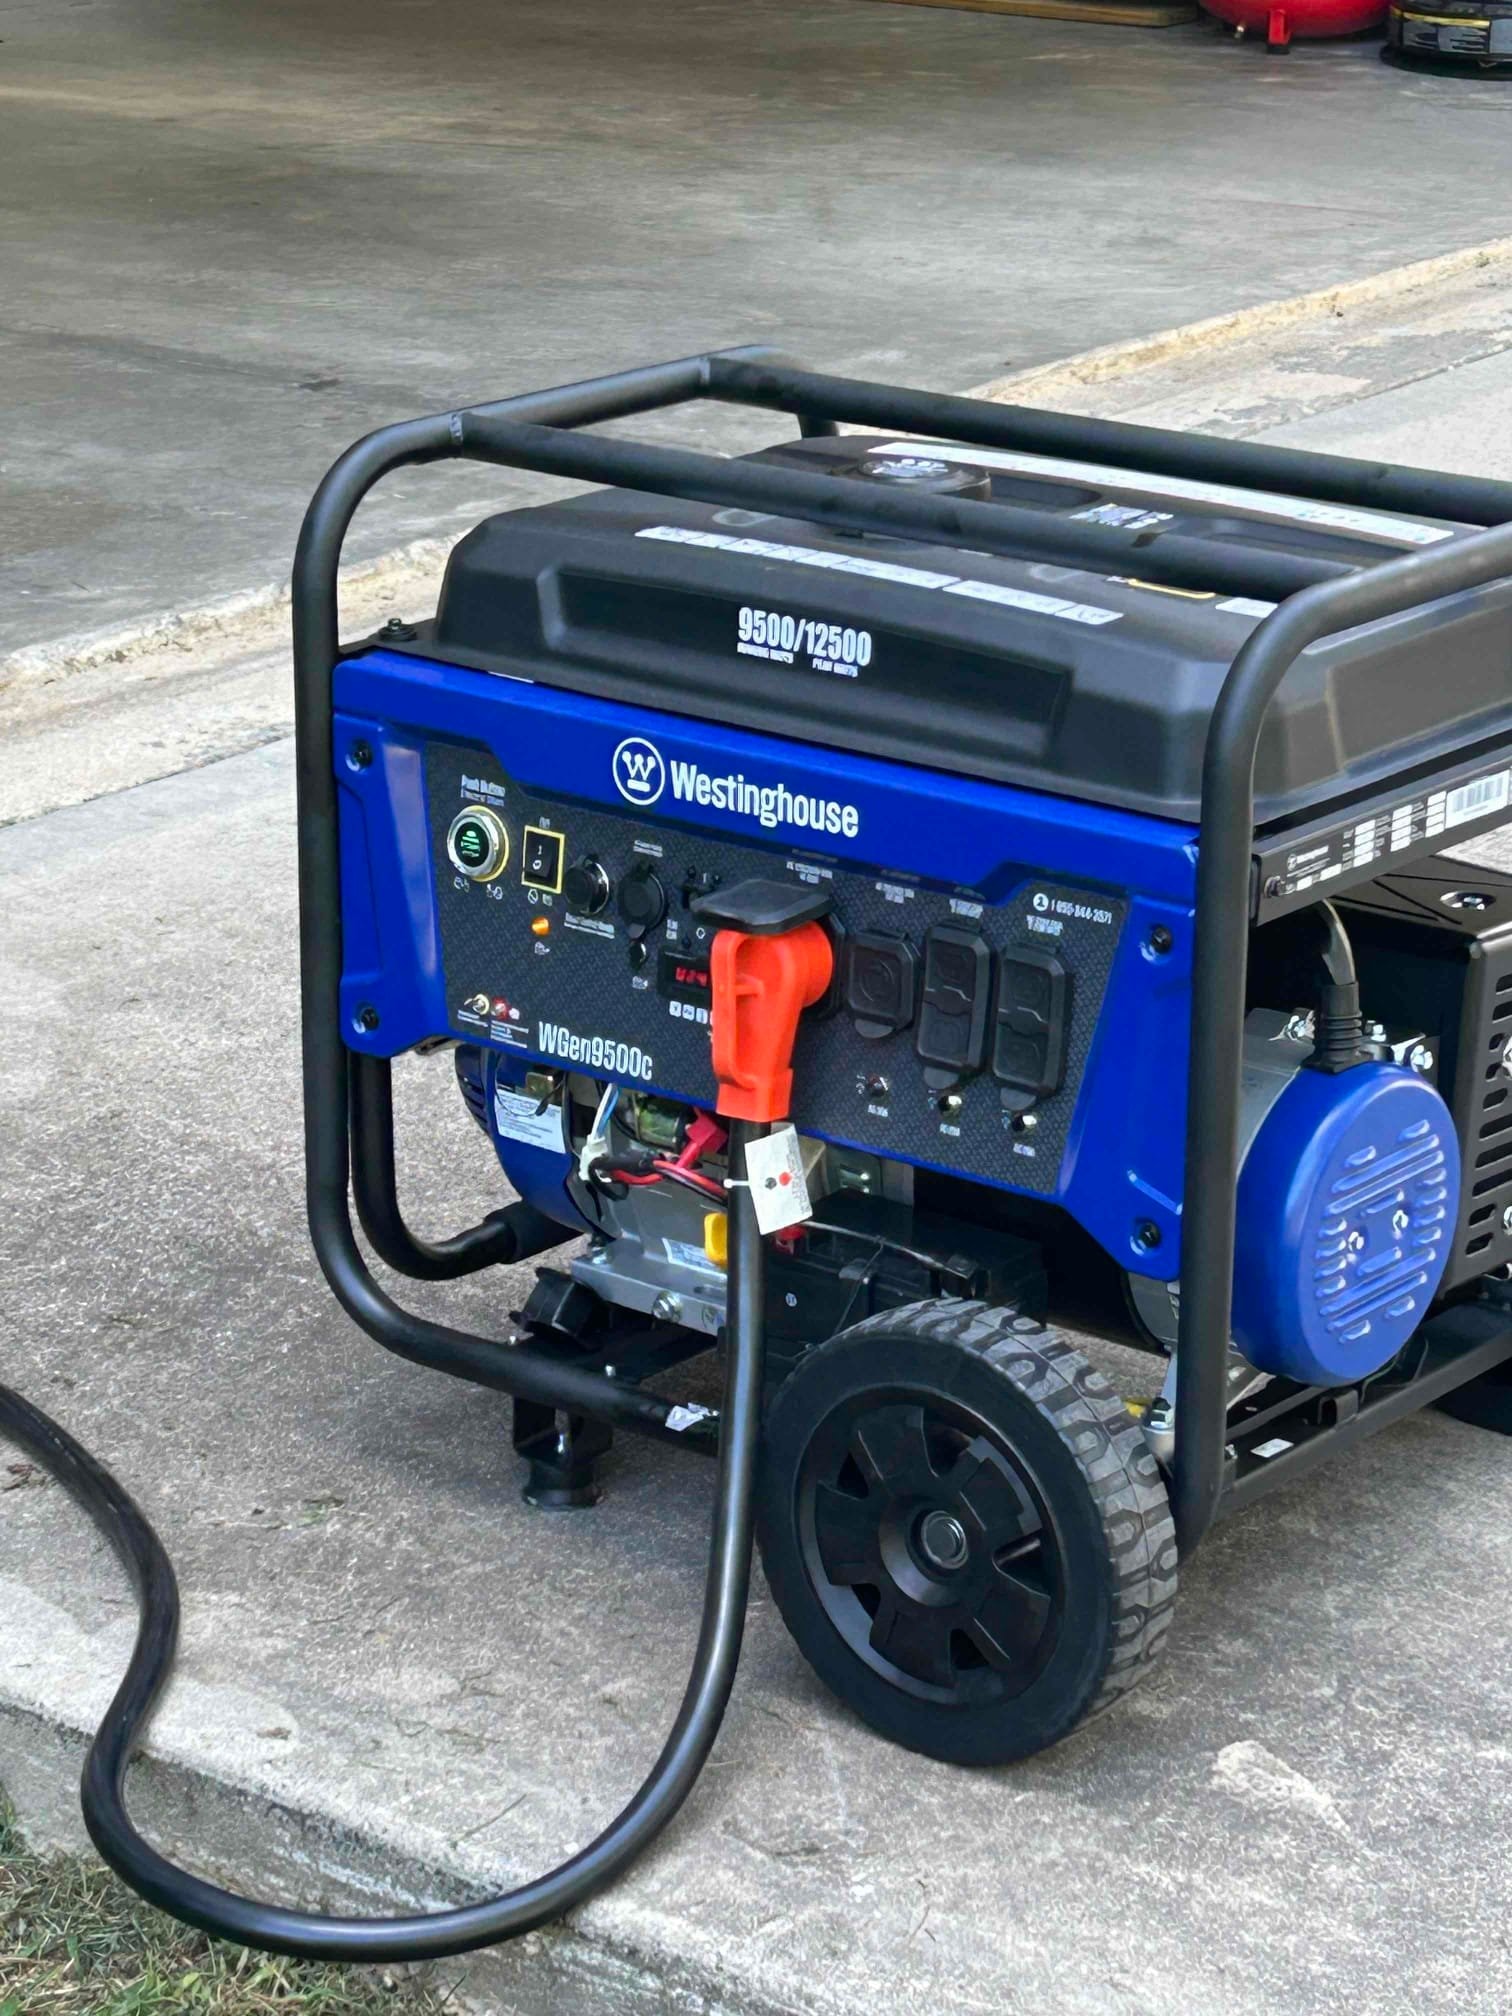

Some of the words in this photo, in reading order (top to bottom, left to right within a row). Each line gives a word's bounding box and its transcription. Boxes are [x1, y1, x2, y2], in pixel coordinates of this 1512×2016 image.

[738, 606, 872, 667] 9500/12500
[670, 759, 859, 838] Westinghouse
[538, 1020, 653, 1081] WGen9500c
